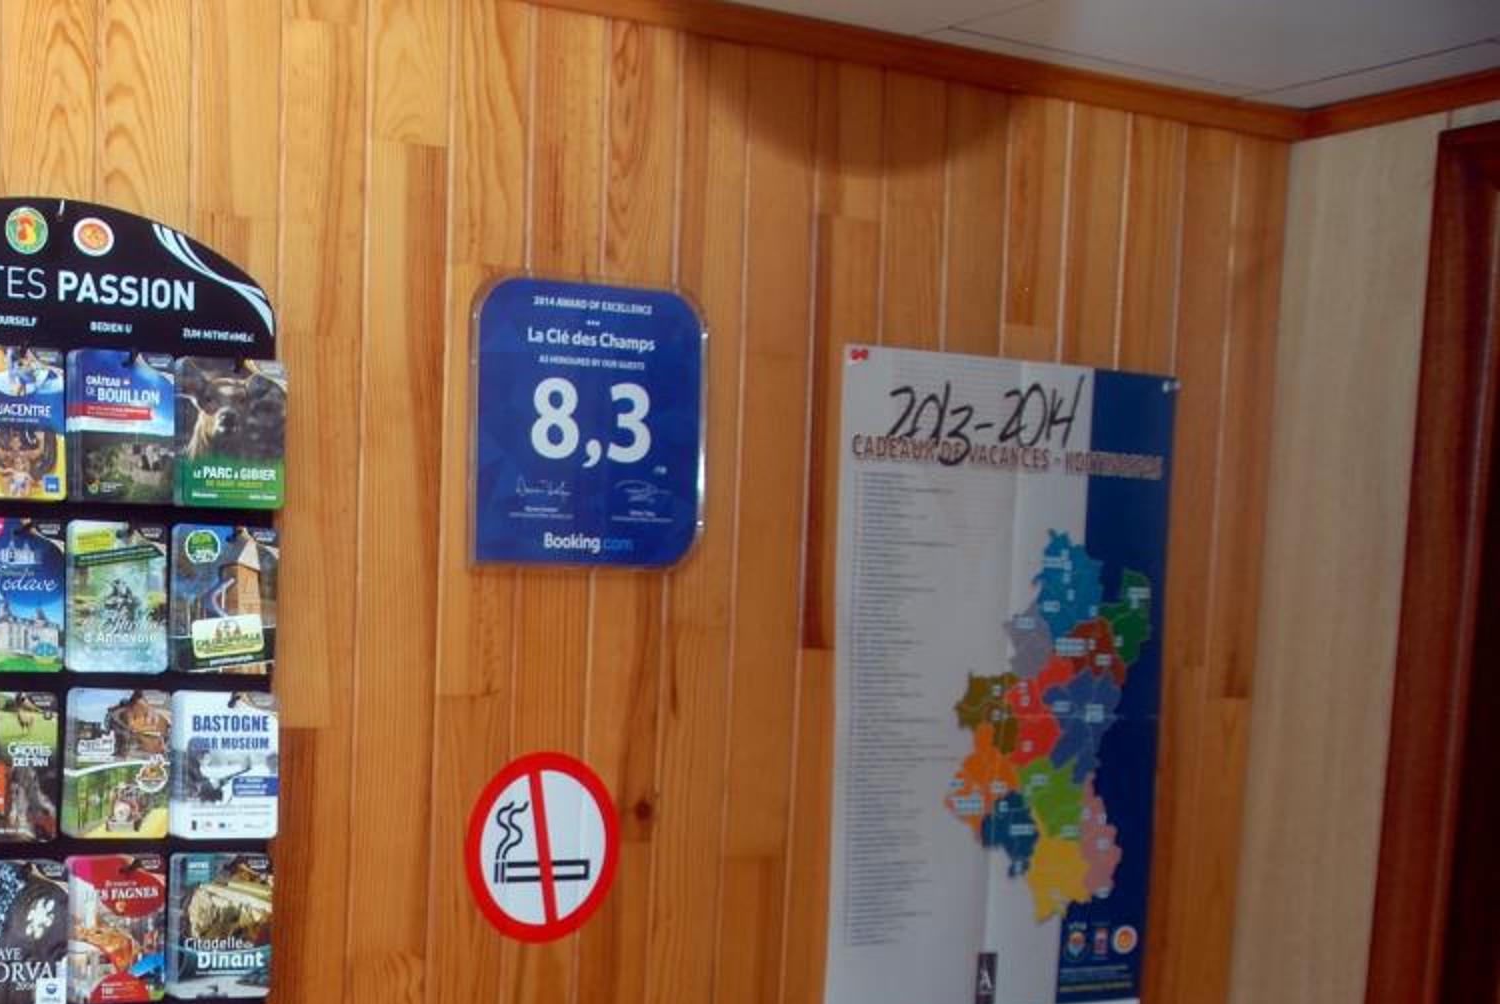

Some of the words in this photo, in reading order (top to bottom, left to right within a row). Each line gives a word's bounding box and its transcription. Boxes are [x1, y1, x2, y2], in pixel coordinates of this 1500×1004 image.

[57, 270, 195, 311] PASSION
[589, 300, 600, 310] OF
[602, 301, 653, 316] EXCELLENCE
[527, 326, 544, 343] La
[546, 328, 569, 345] Clé
[571, 331, 597, 347] des
[599, 332, 656, 354] Champs
[97, 387, 160, 406] BOUILLON
[531, 377, 651, 468] 8,3
[852, 434, 938, 461] CADEAUX
[968, 443, 1050, 470] VACANCES
[203, 466, 233, 479] PARC
[240, 467, 277, 481] GIBIER
[543, 531, 634, 553] Booking.com
[192, 715, 270, 733] BASTOGNE
[193, 737, 219, 749] WAR
[221, 737, 270, 750] MUSEUM
[110, 887, 160, 900] FAGNES
[184, 936, 244, 950] Citadelle
[196, 950, 265, 969] Dinant
